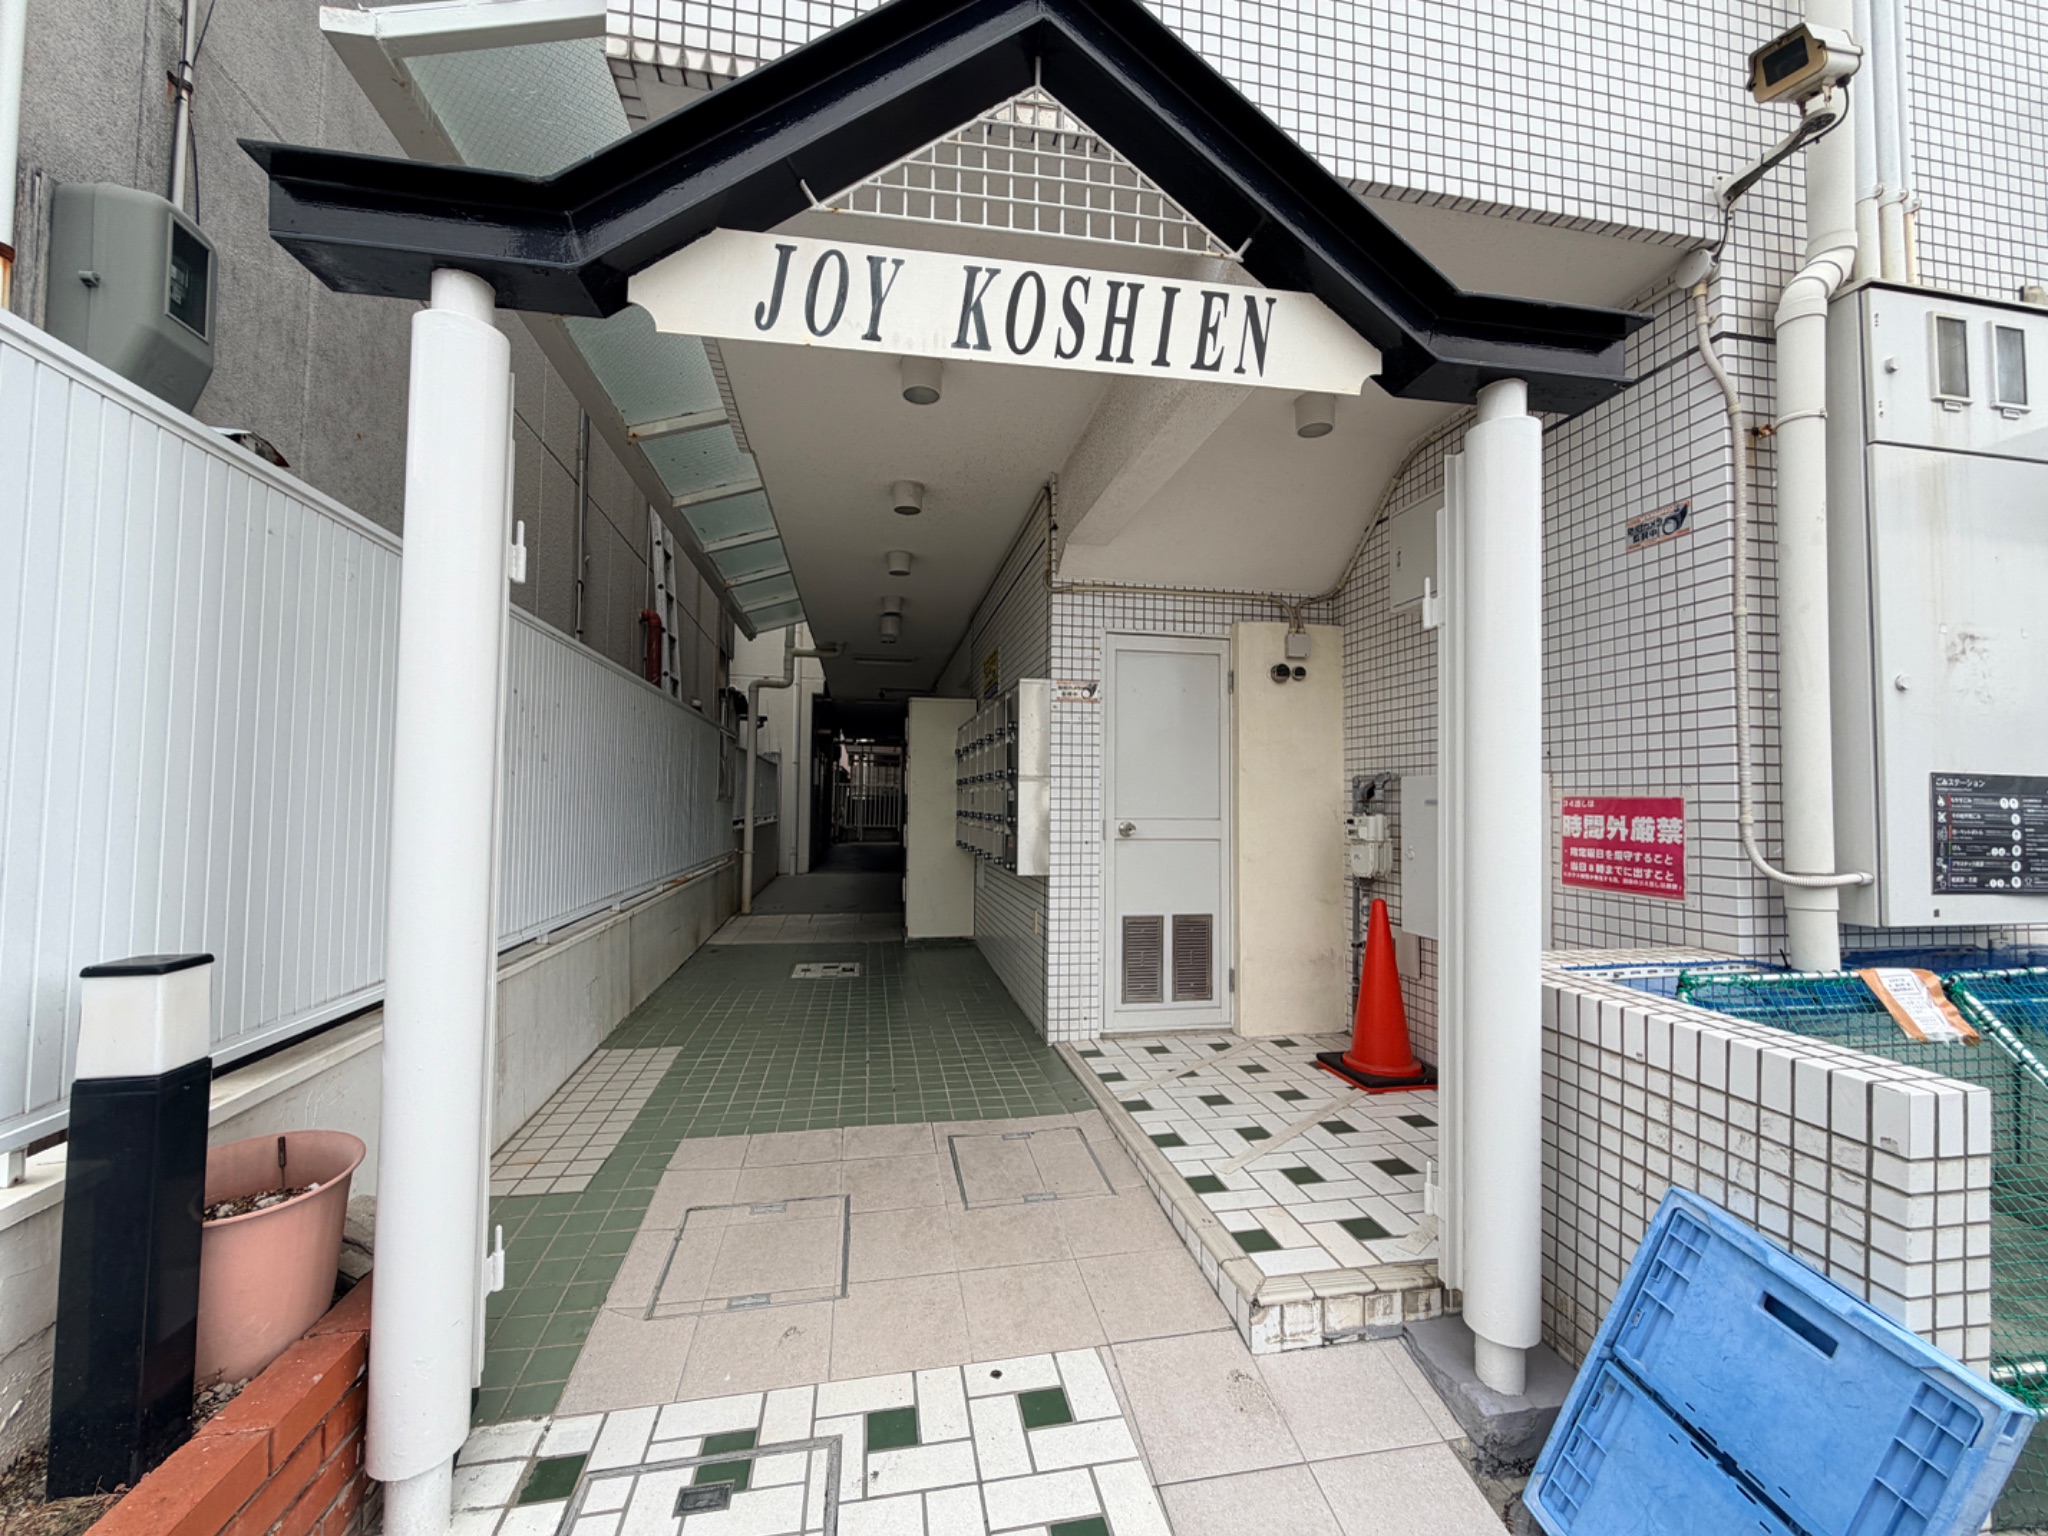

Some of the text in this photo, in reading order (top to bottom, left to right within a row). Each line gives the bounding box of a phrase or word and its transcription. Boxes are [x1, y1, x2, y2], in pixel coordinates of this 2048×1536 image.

[754, 243, 1277, 379] JOY KOSHIEN
[1936, 778, 1985, 788] ごみステーション
[1562, 815, 1682, 844] 時間外厳禁
